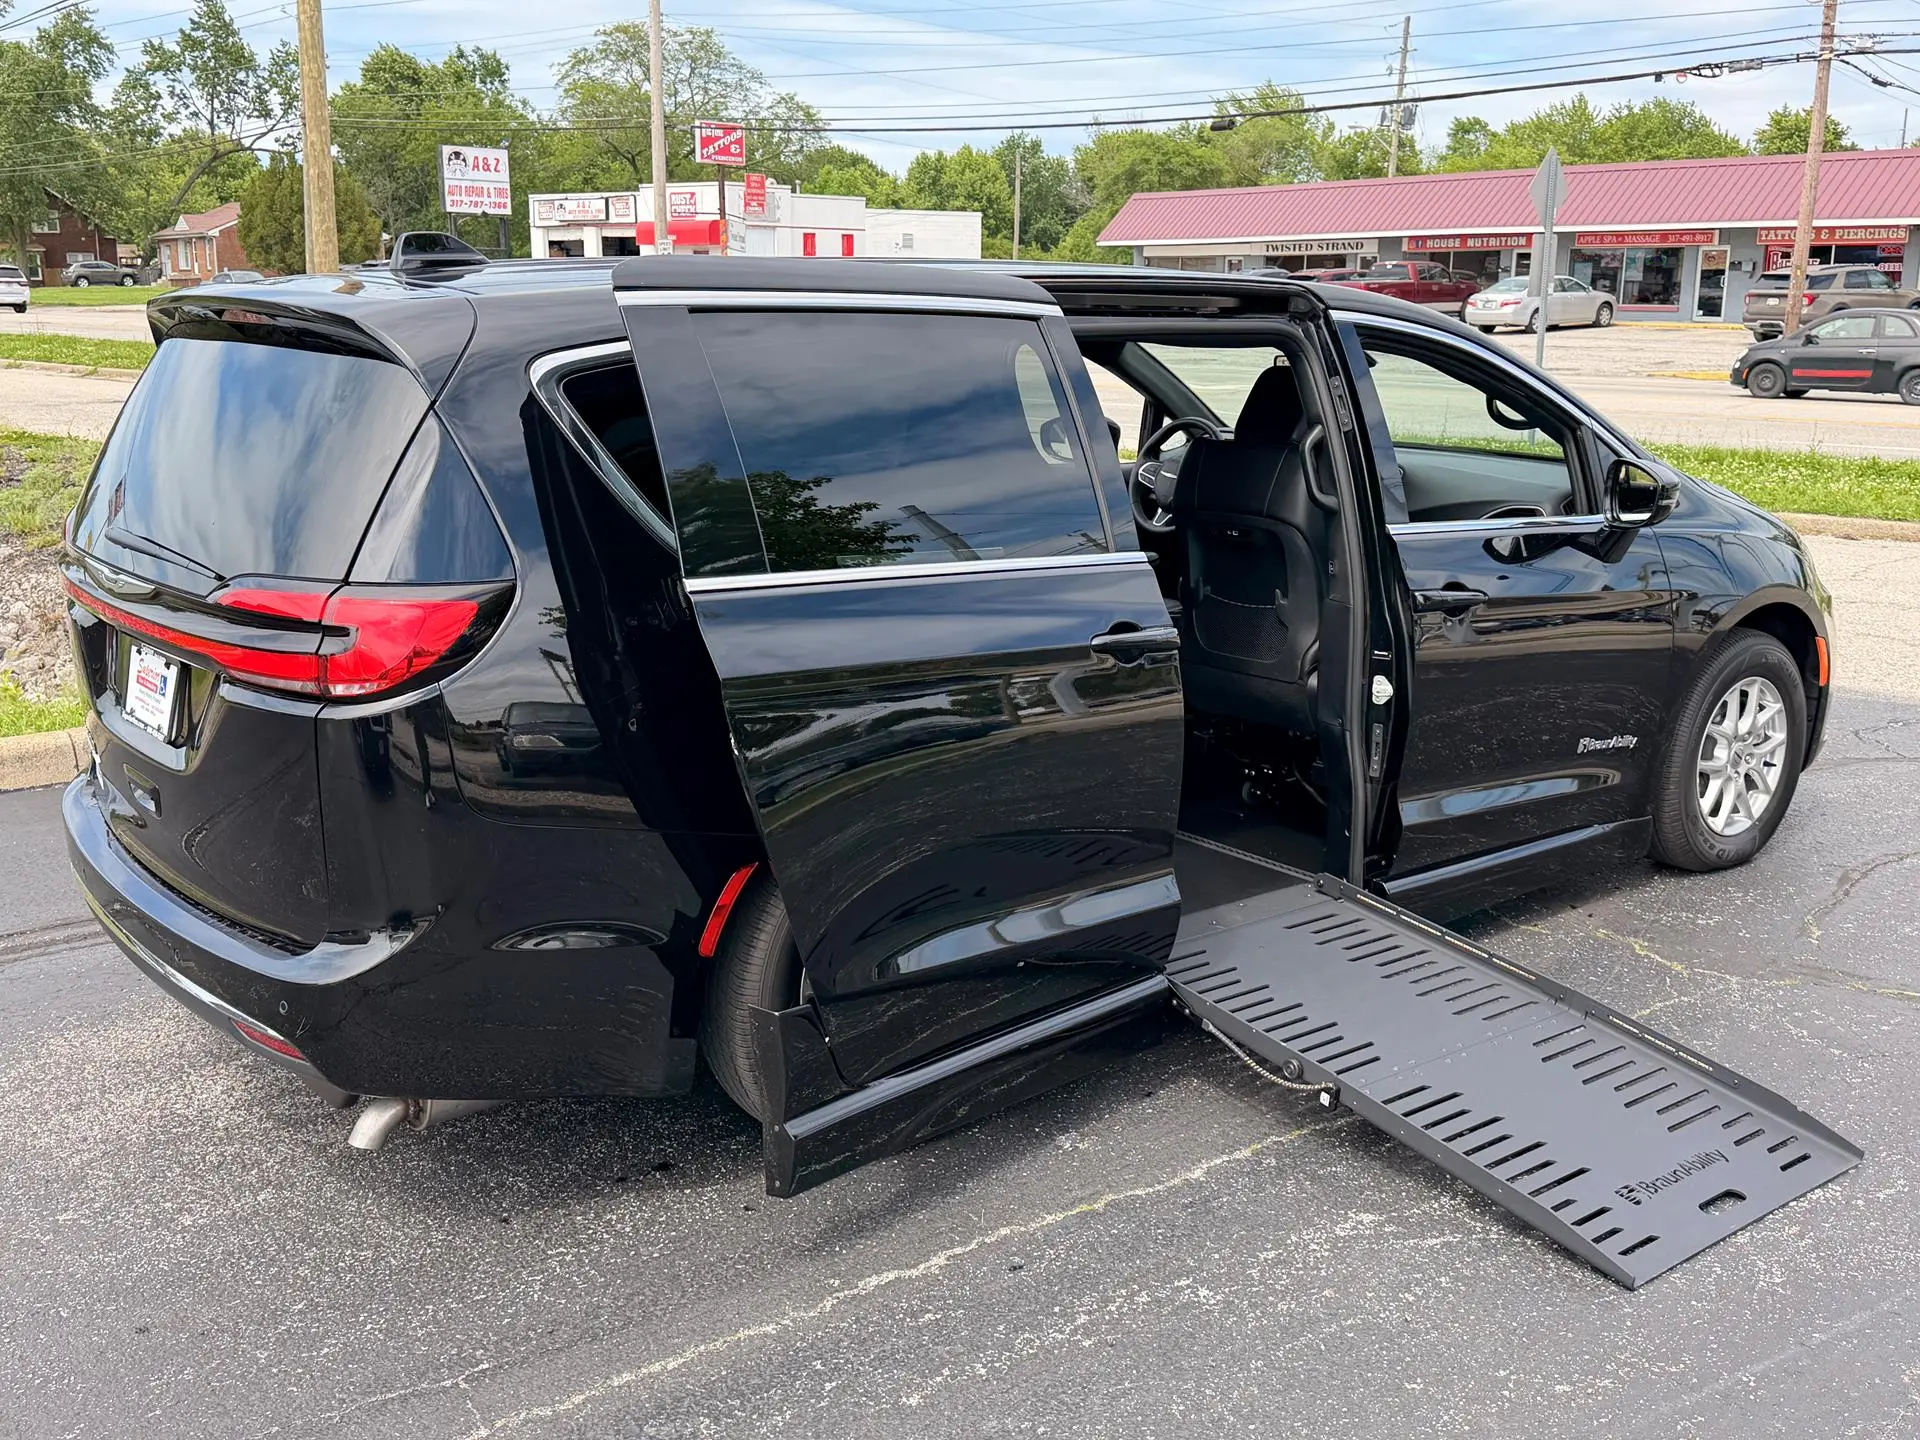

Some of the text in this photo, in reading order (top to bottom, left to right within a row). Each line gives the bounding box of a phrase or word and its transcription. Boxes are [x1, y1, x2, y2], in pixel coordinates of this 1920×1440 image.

[702, 129, 742, 158] TATTOOS
[472, 156, 500, 172] A & Z
[448, 185, 508, 199] AUTO REPAIR & TIRES
[449, 200, 508, 209] 317-787-1366
[1579, 236, 1601, 244] APPLE
[1603, 235, 1617, 243] SPA
[1623, 234, 1660, 242] MASSAGE
[1821, 229, 1829, 238] &
[1834, 227, 1906, 240] PIERCINGS
[1265, 241, 1364, 252] TWISTED STRAND
[1427, 237, 1526, 248] HOUSE NUTRITION
[1635, 1149, 1730, 1200] BraunAbility
